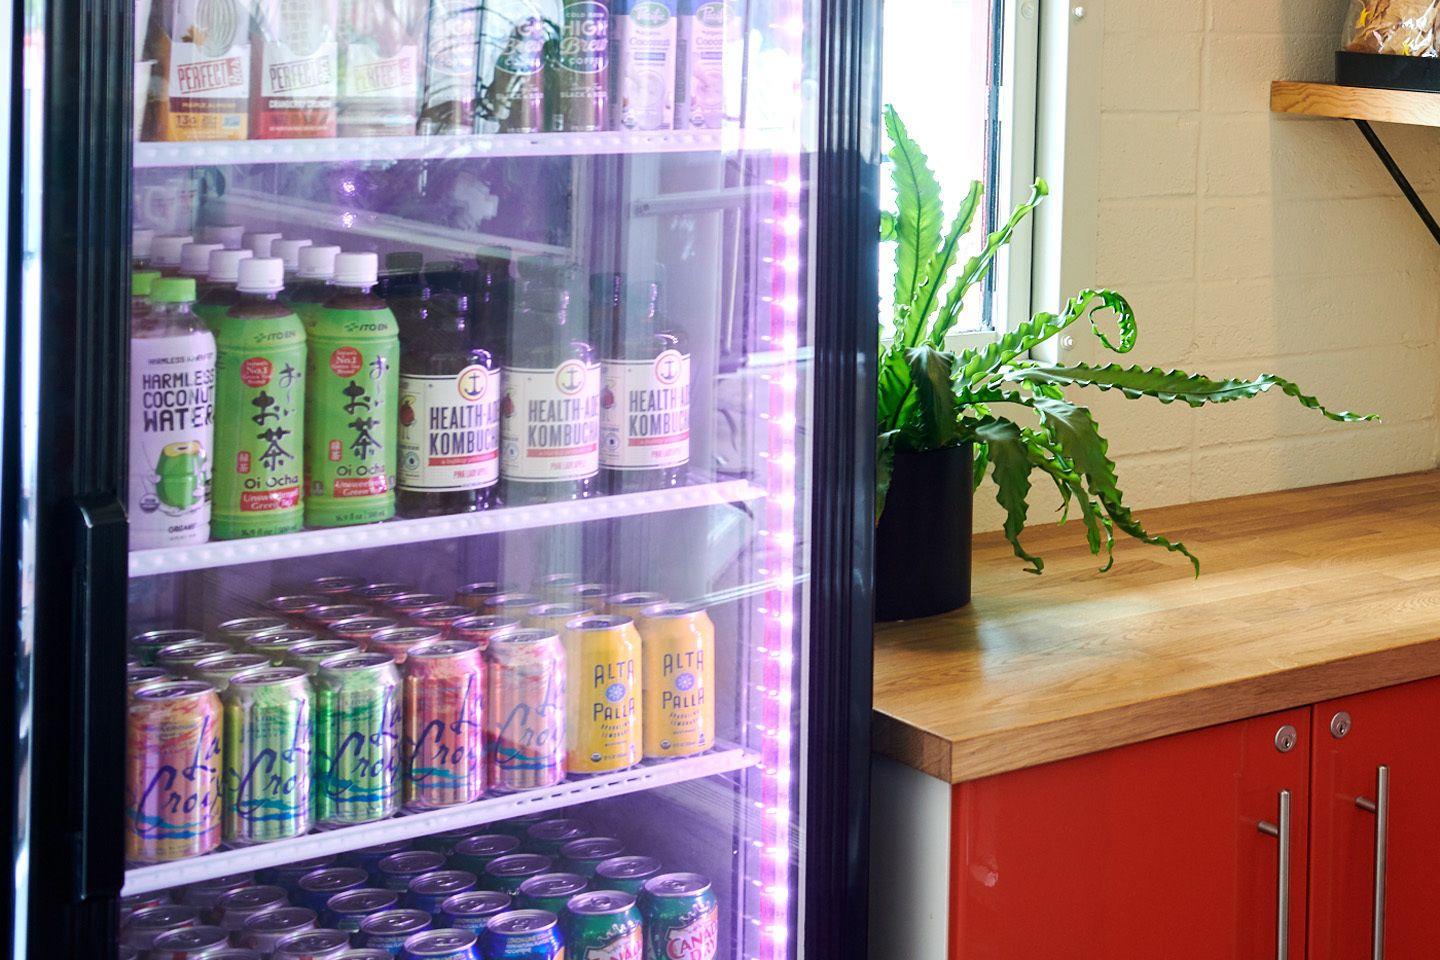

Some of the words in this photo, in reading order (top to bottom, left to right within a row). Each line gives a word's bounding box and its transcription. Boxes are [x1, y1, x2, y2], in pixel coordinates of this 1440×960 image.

[562, 20, 609, 36] HIGH
[177, 62, 227, 92] PERFECT
[143, 368, 215, 389] HARMLESS
[143, 405, 214, 433] WATER
[252, 391, 294, 472] お茶
[342, 381, 383, 460] お茶
[244, 478, 261, 490] Oi
[266, 475, 299, 489] Ocha
[336, 465, 353, 476] Oi
[594, 659, 634, 688] ALTA
[663, 650, 704, 677] ALTA
[593, 698, 635, 722] PALLA
[662, 690, 704, 709] PALLA
